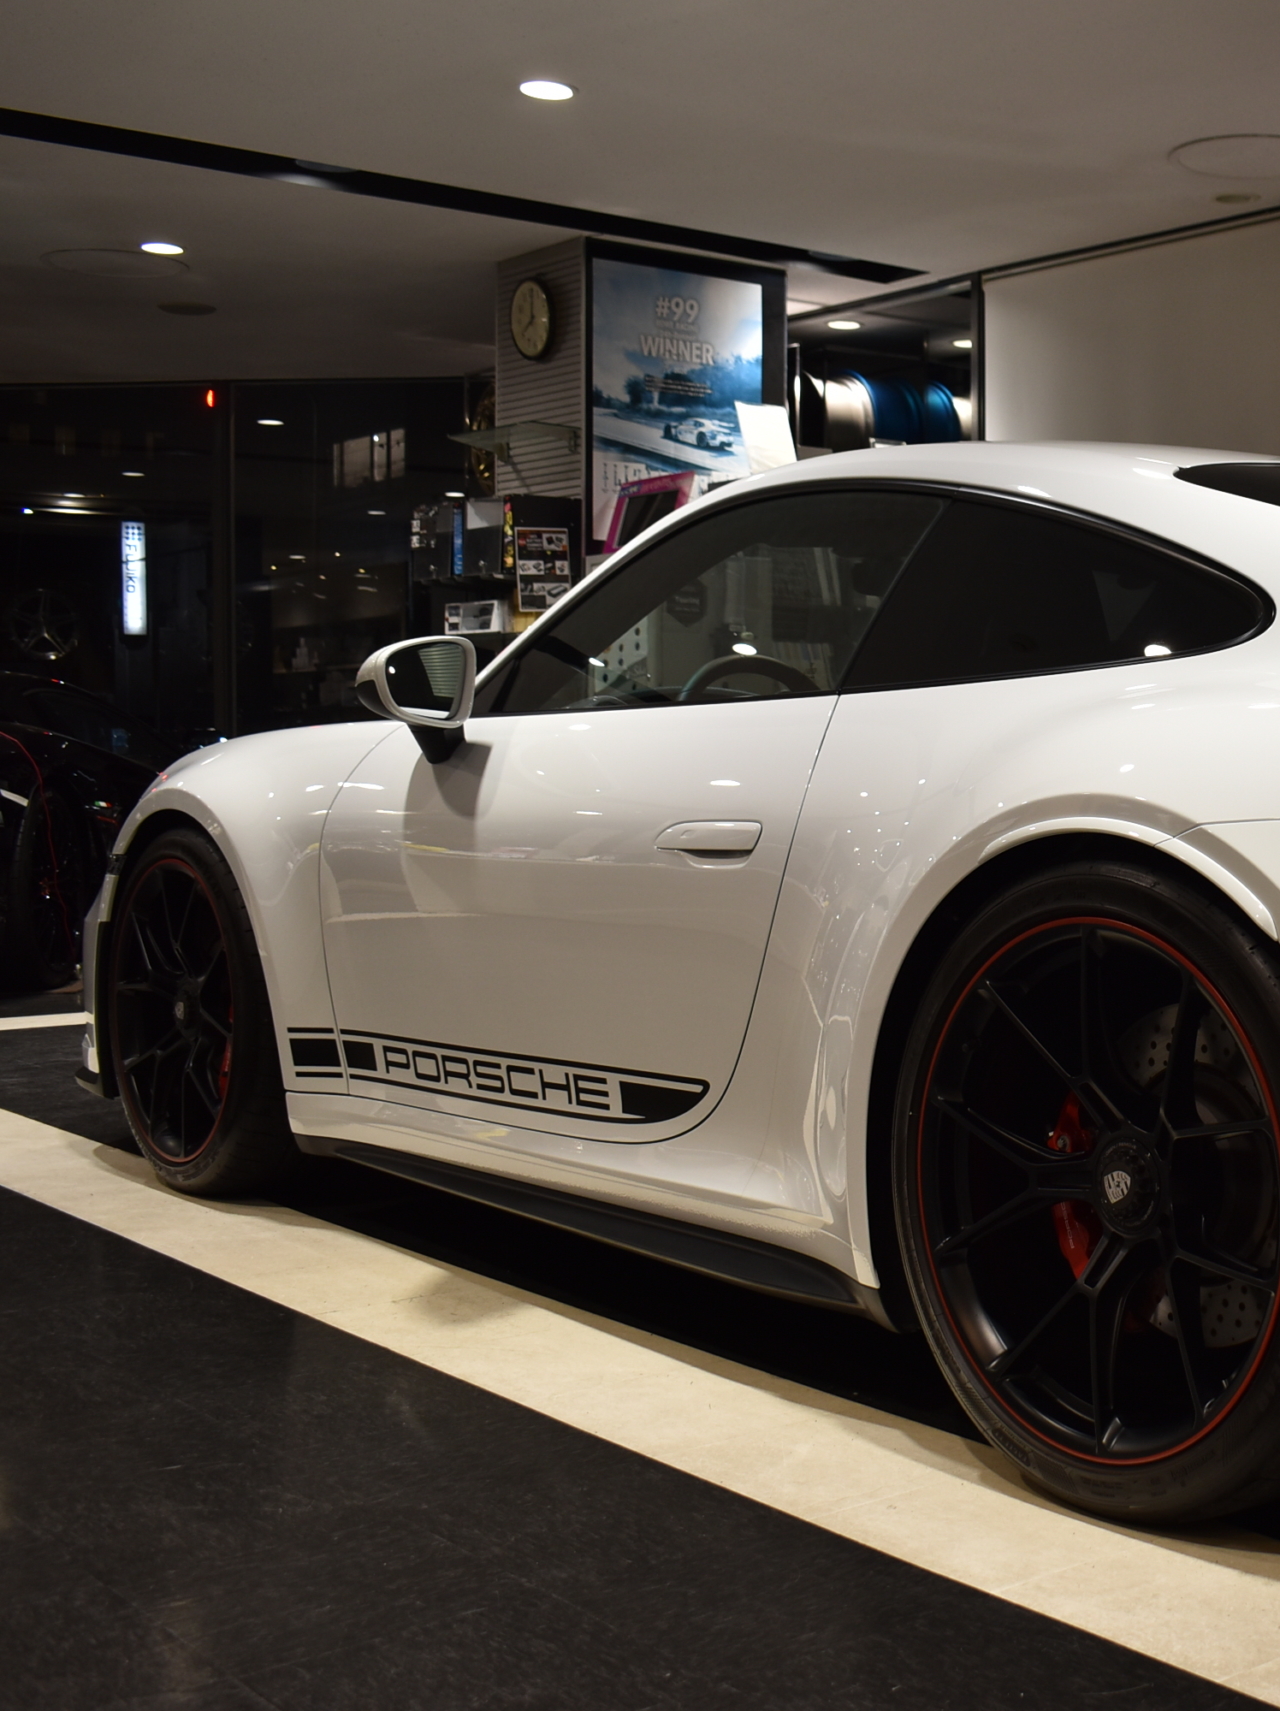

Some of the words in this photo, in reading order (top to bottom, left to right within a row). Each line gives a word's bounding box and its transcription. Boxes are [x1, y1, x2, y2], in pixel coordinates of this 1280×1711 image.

[655, 296, 699, 323] #99
[640, 334, 715, 366] WINNER
[381, 1044, 611, 1112] PORSCHE
